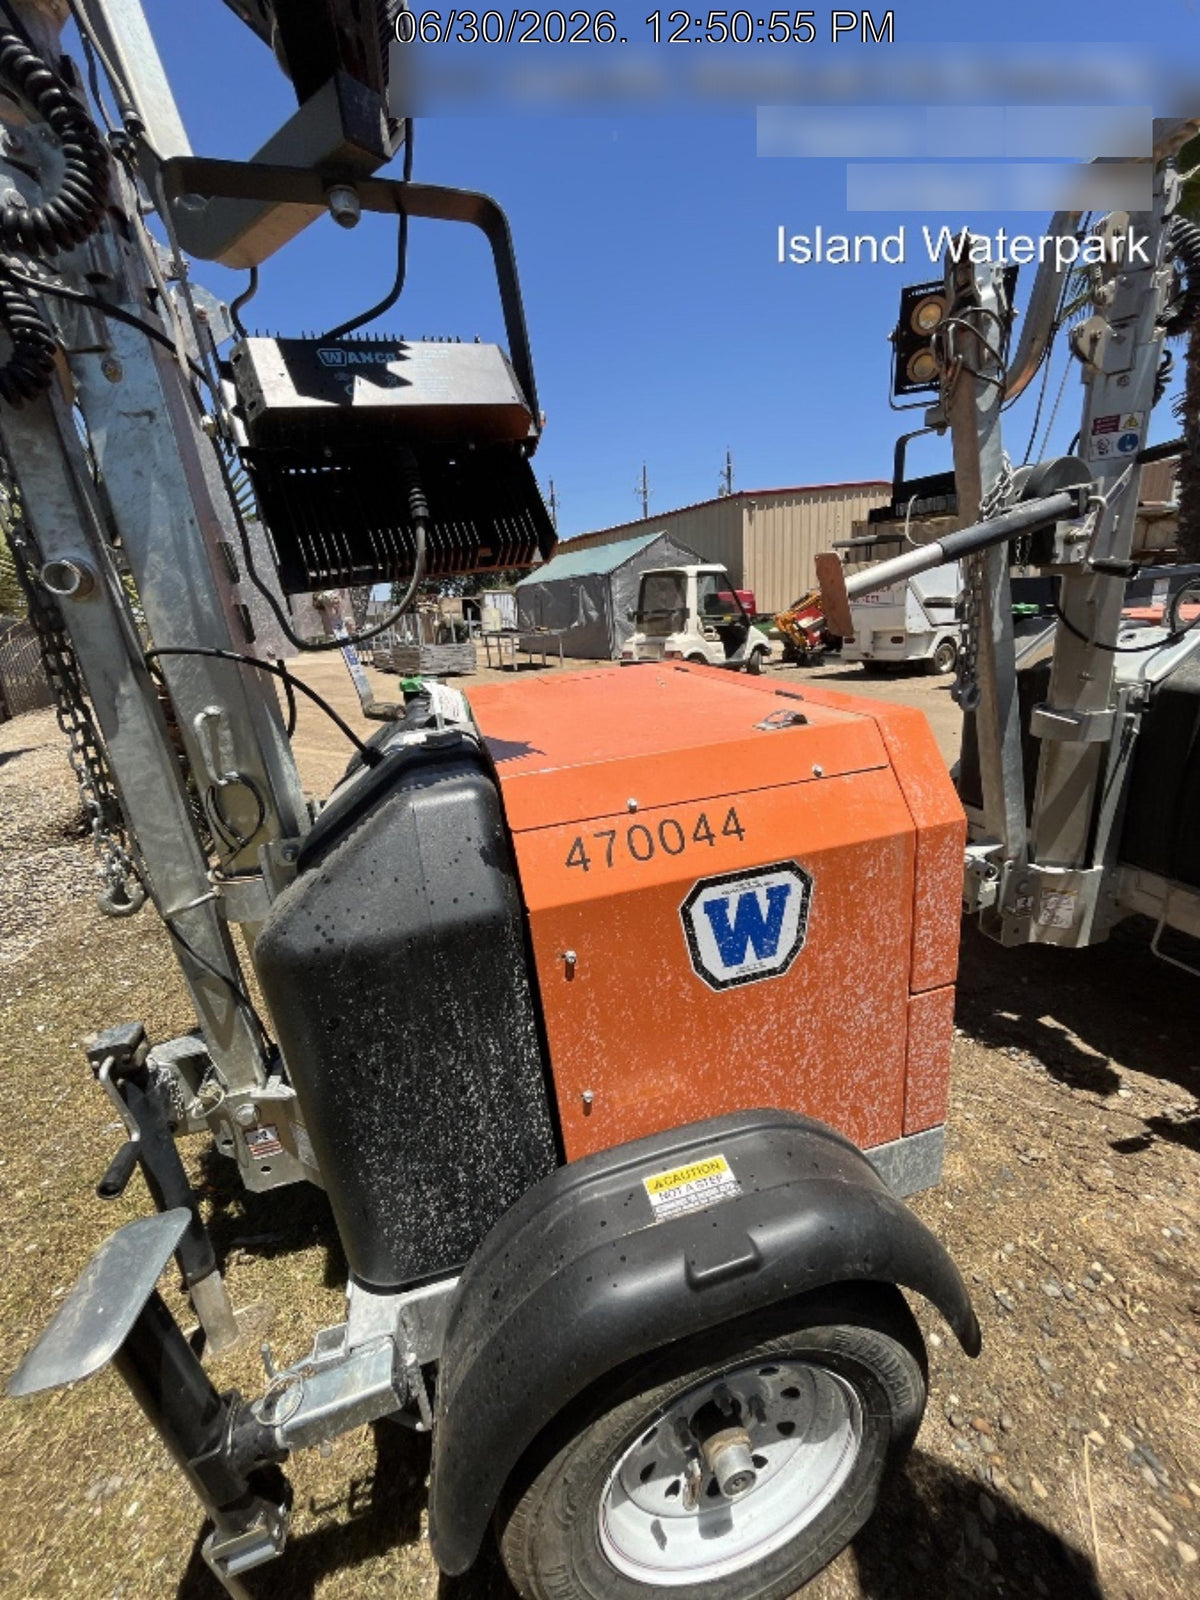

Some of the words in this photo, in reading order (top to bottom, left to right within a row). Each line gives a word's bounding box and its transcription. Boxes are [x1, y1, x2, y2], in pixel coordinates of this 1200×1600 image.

[317, 349, 397, 366] WANCO
[565, 807, 746, 872] 470044
[703, 883, 792, 968] W
[663, 1161, 721, 1185] CAUTION
[659, 1187, 681, 1201] NOT
[696, 1174, 723, 1189] STEP
